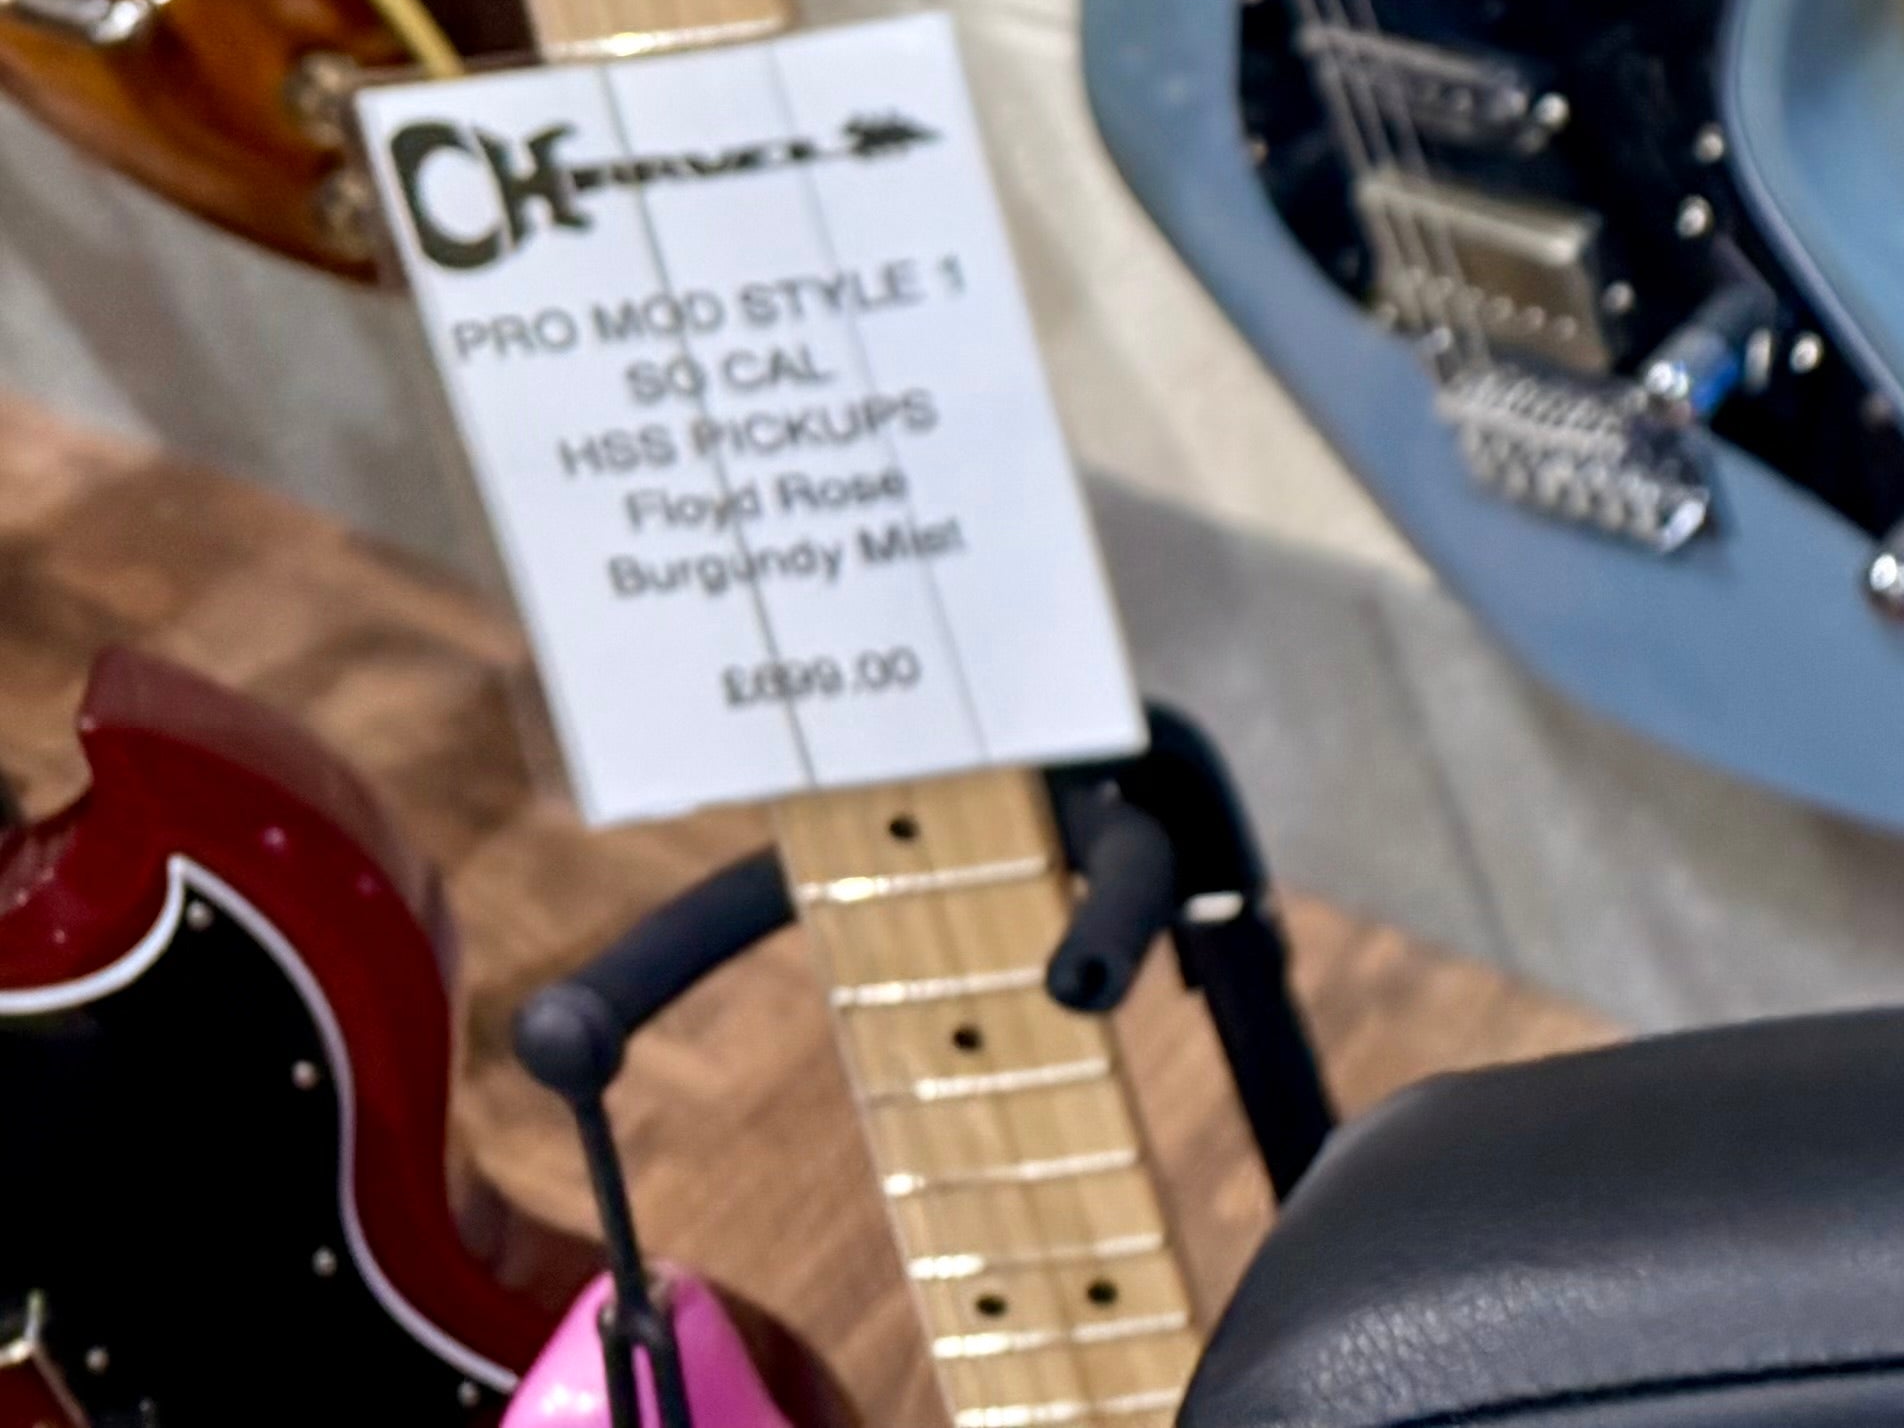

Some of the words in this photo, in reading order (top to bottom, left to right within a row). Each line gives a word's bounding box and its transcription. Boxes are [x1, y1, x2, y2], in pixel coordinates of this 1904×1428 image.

[453, 307, 578, 361] PRO
[591, 289, 725, 344] MOD
[739, 257, 923, 328] STYLE
[626, 354, 707, 406] SO
[721, 344, 838, 391] CAL
[558, 422, 678, 476] HSS
[689, 387, 940, 457] PICKUPS
[622, 478, 760, 535] Floyd
[775, 466, 908, 513] Rose
[607, 536, 843, 598] Burgundy
[855, 515, 967, 565] Mist
